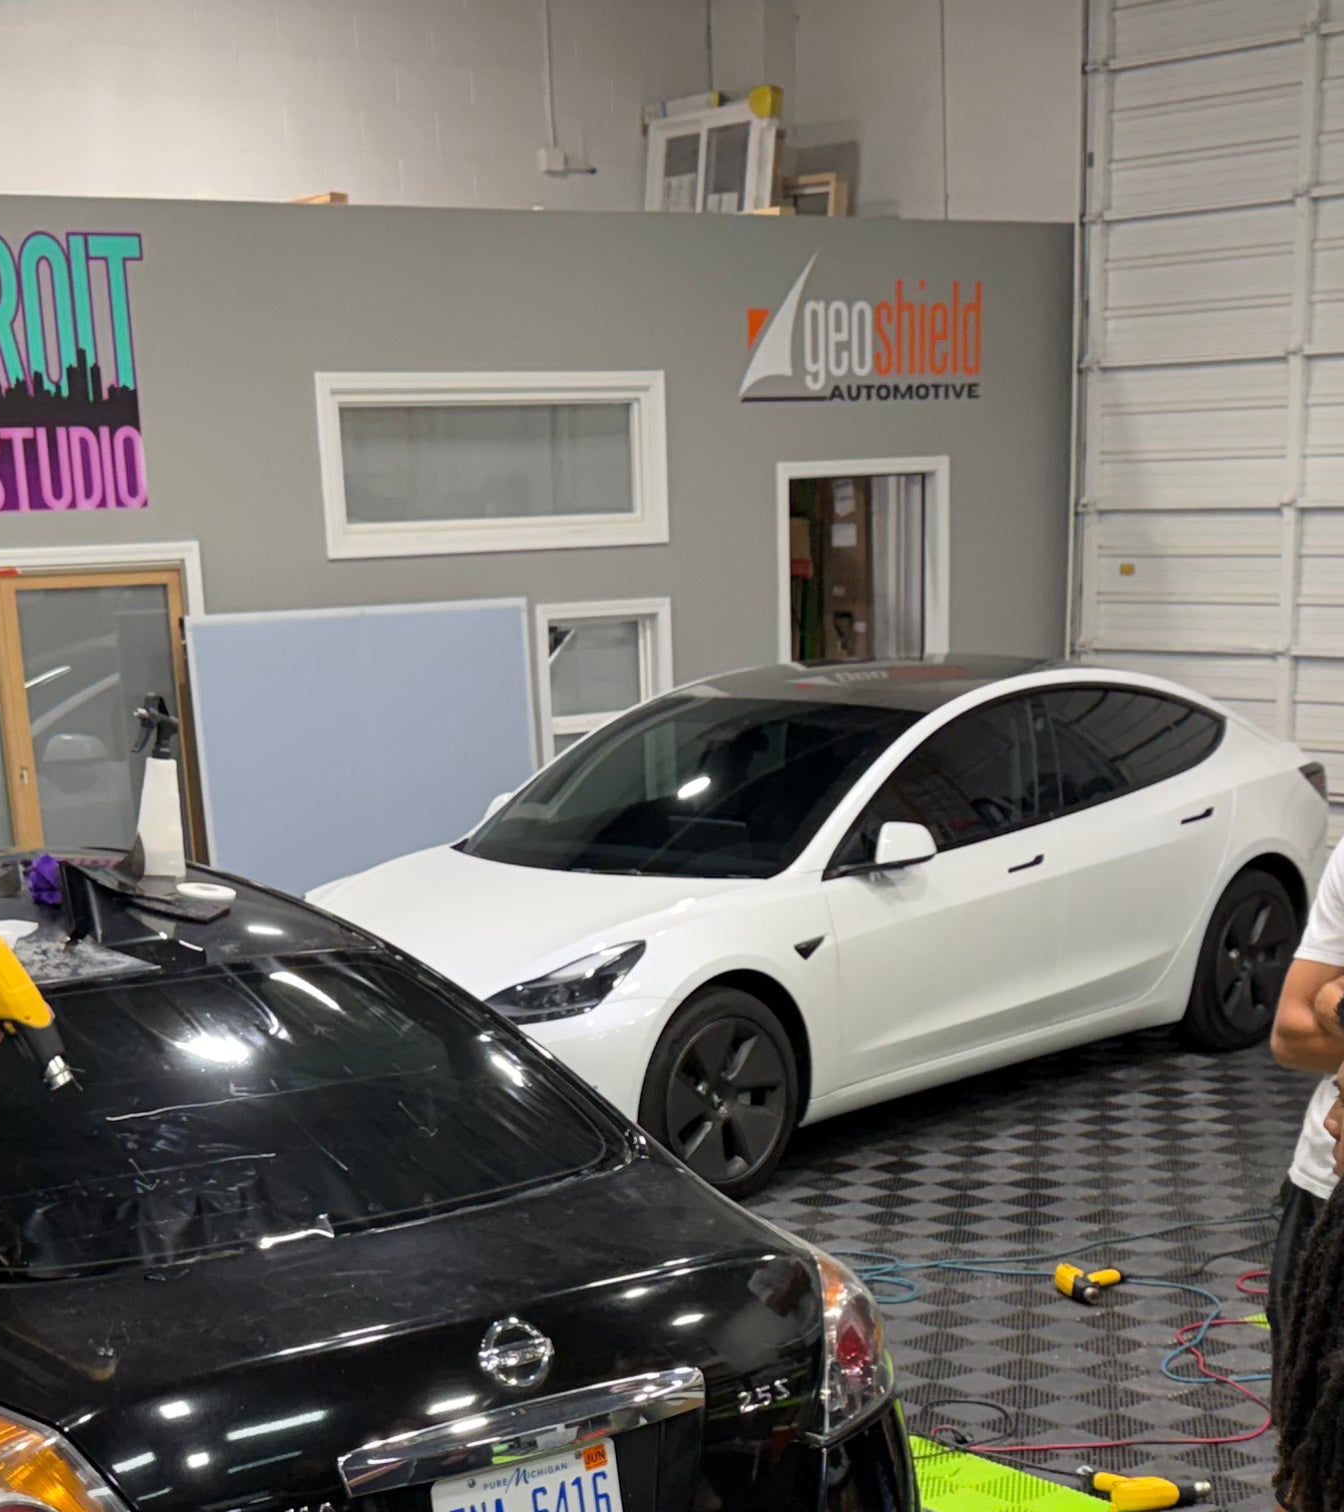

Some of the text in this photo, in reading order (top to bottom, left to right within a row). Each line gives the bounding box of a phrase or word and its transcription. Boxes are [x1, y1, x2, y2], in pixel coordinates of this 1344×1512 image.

[804, 277, 983, 391] geoshield
[829, 383, 981, 401] AUTOMOTIVE
[585, 1447, 606, 1465] JUN
[483, 1477, 507, 1491] PURE
